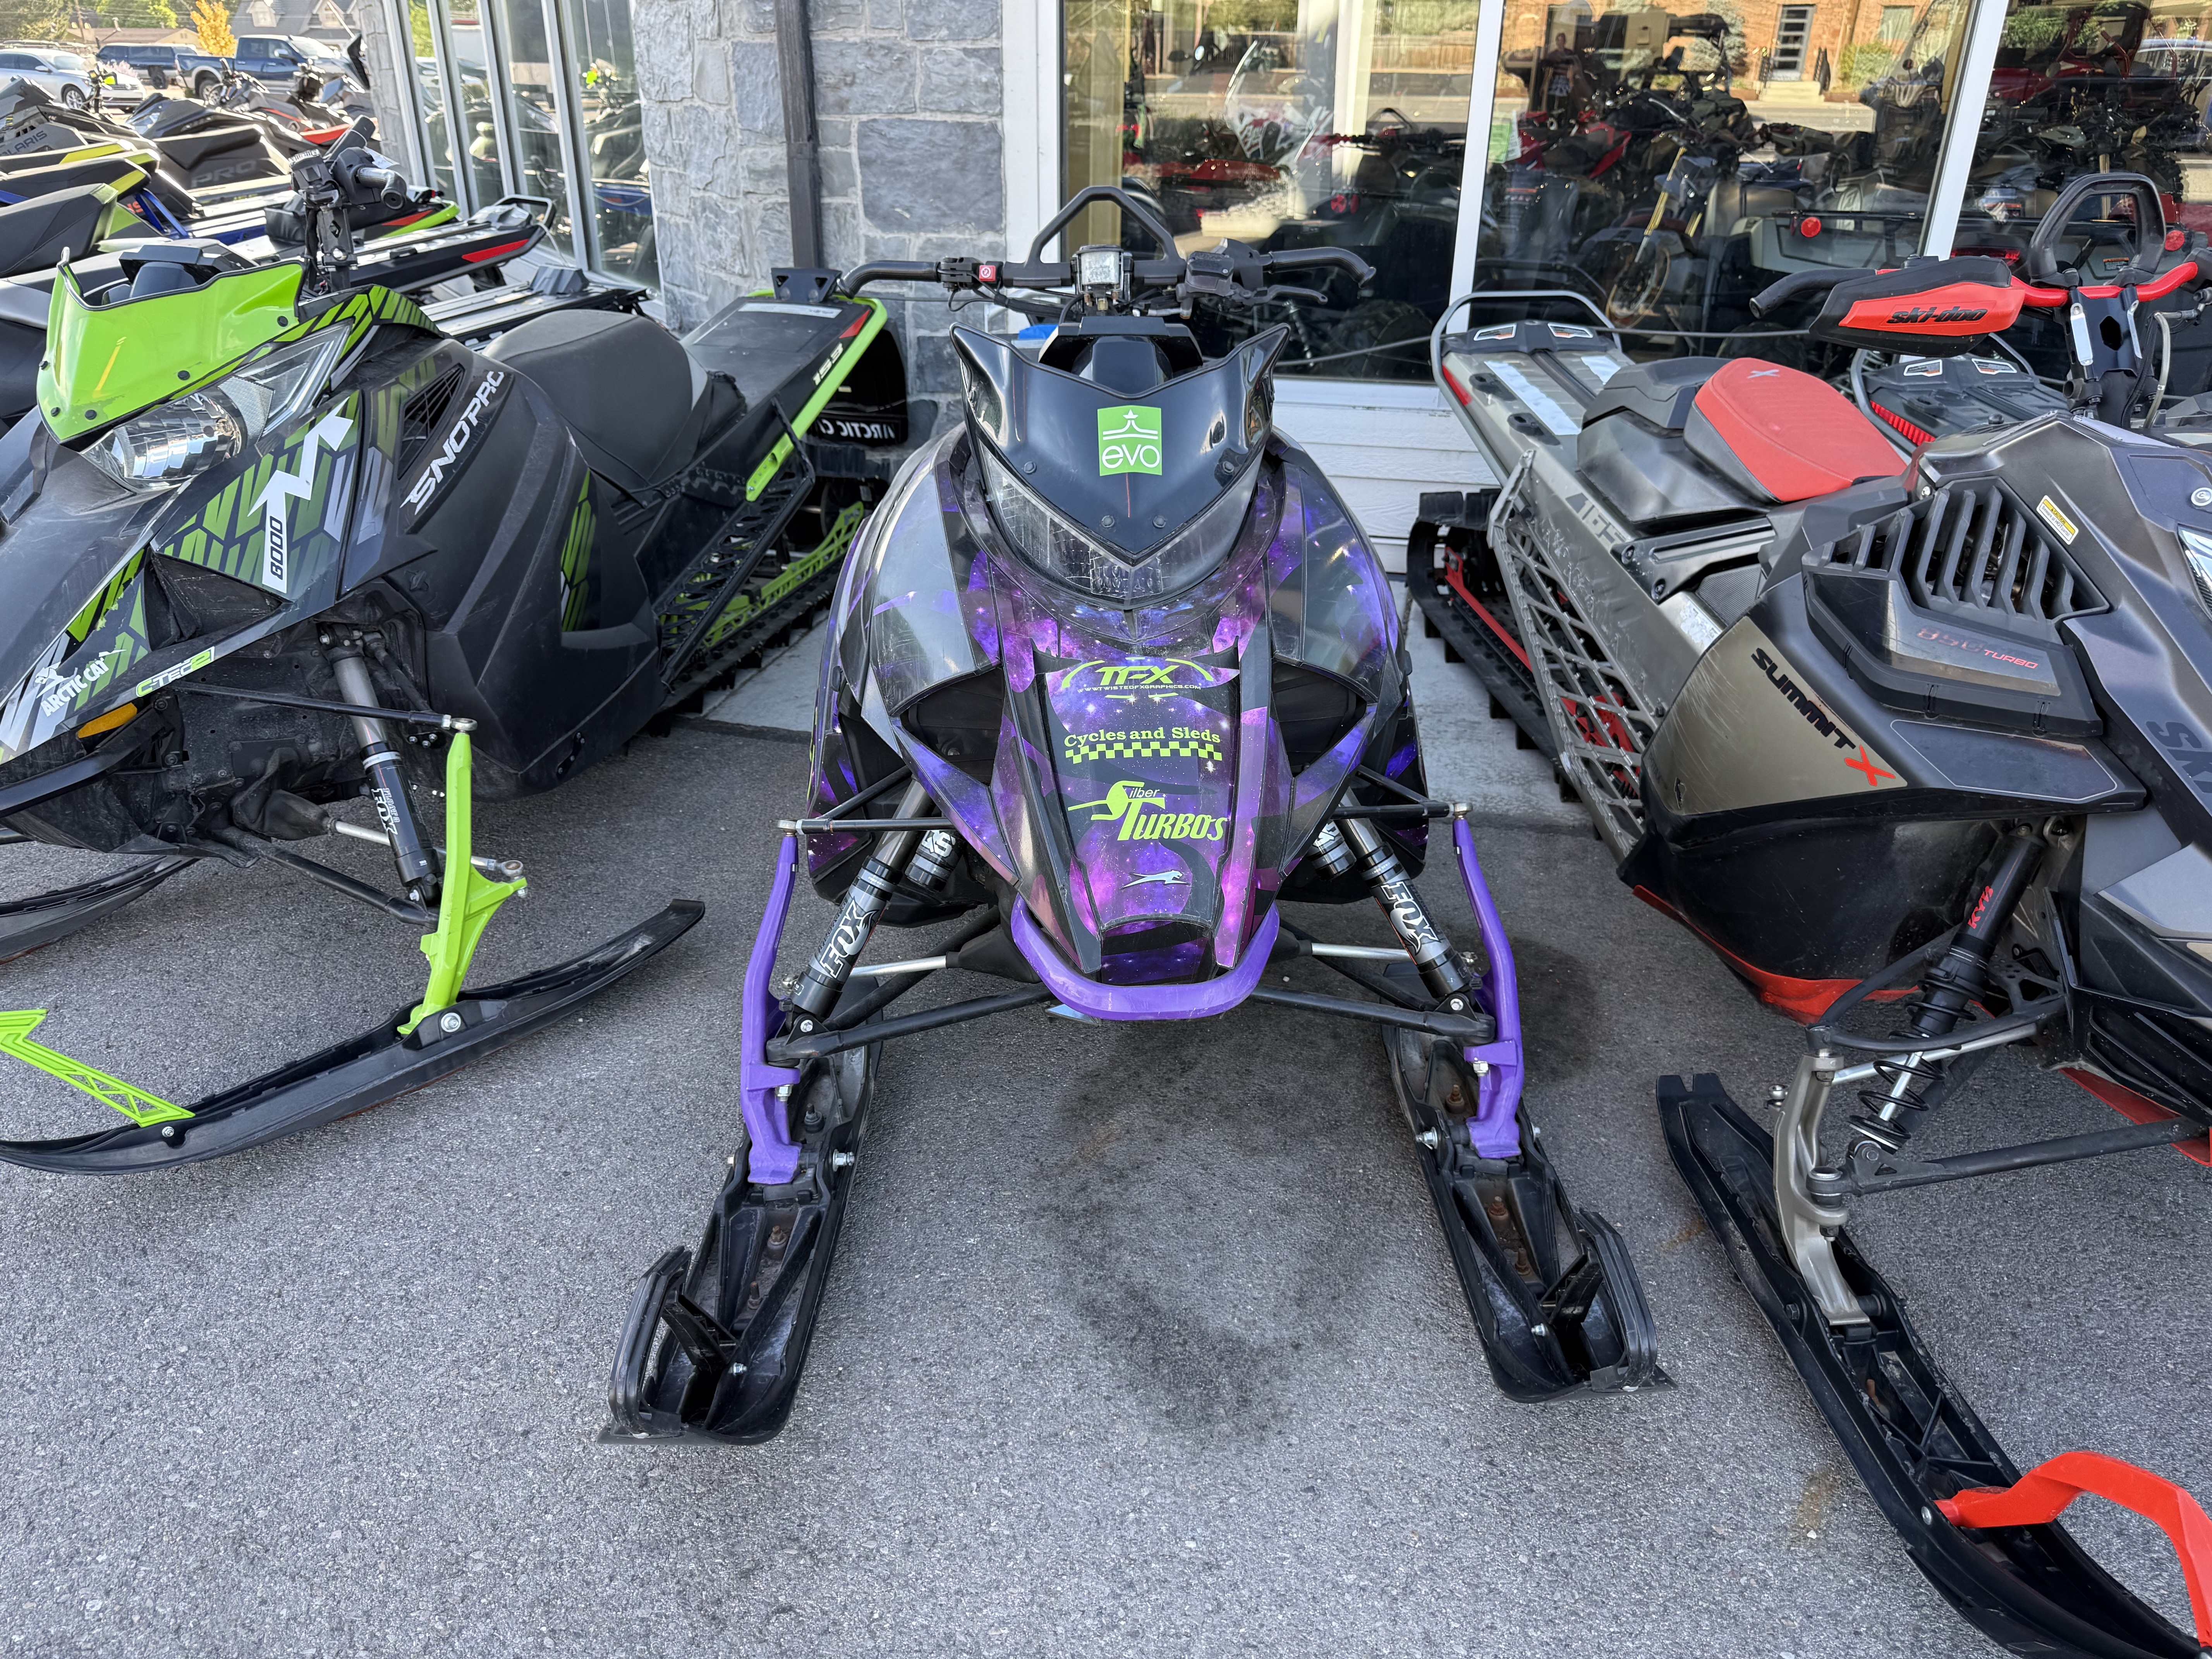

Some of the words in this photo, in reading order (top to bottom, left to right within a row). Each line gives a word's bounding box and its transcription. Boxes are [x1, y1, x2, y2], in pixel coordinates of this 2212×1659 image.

[191, 160, 257, 187] PRO
[812, 342, 843, 385] 153
[1102, 444, 1160, 469] evo
[270, 516, 283, 580] 8000
[1096, 665, 1180, 685] TFX
[1984, 649, 2038, 669] TURBO
[41, 675, 88, 717] ARCTIC
[83, 657, 109, 682] CAT
[1064, 729, 1126, 748] Cycles
[1130, 727, 1165, 740] and
[1172, 727, 1221, 744] Sleds
[1751, 647, 1856, 749] SUMMIT
[1844, 745, 1896, 787] X
[371, 788, 398, 835] FOX
[1381, 881, 1440, 941] FOX
[1968, 886, 1994, 929] KYB
[819, 900, 872, 978] FOX
